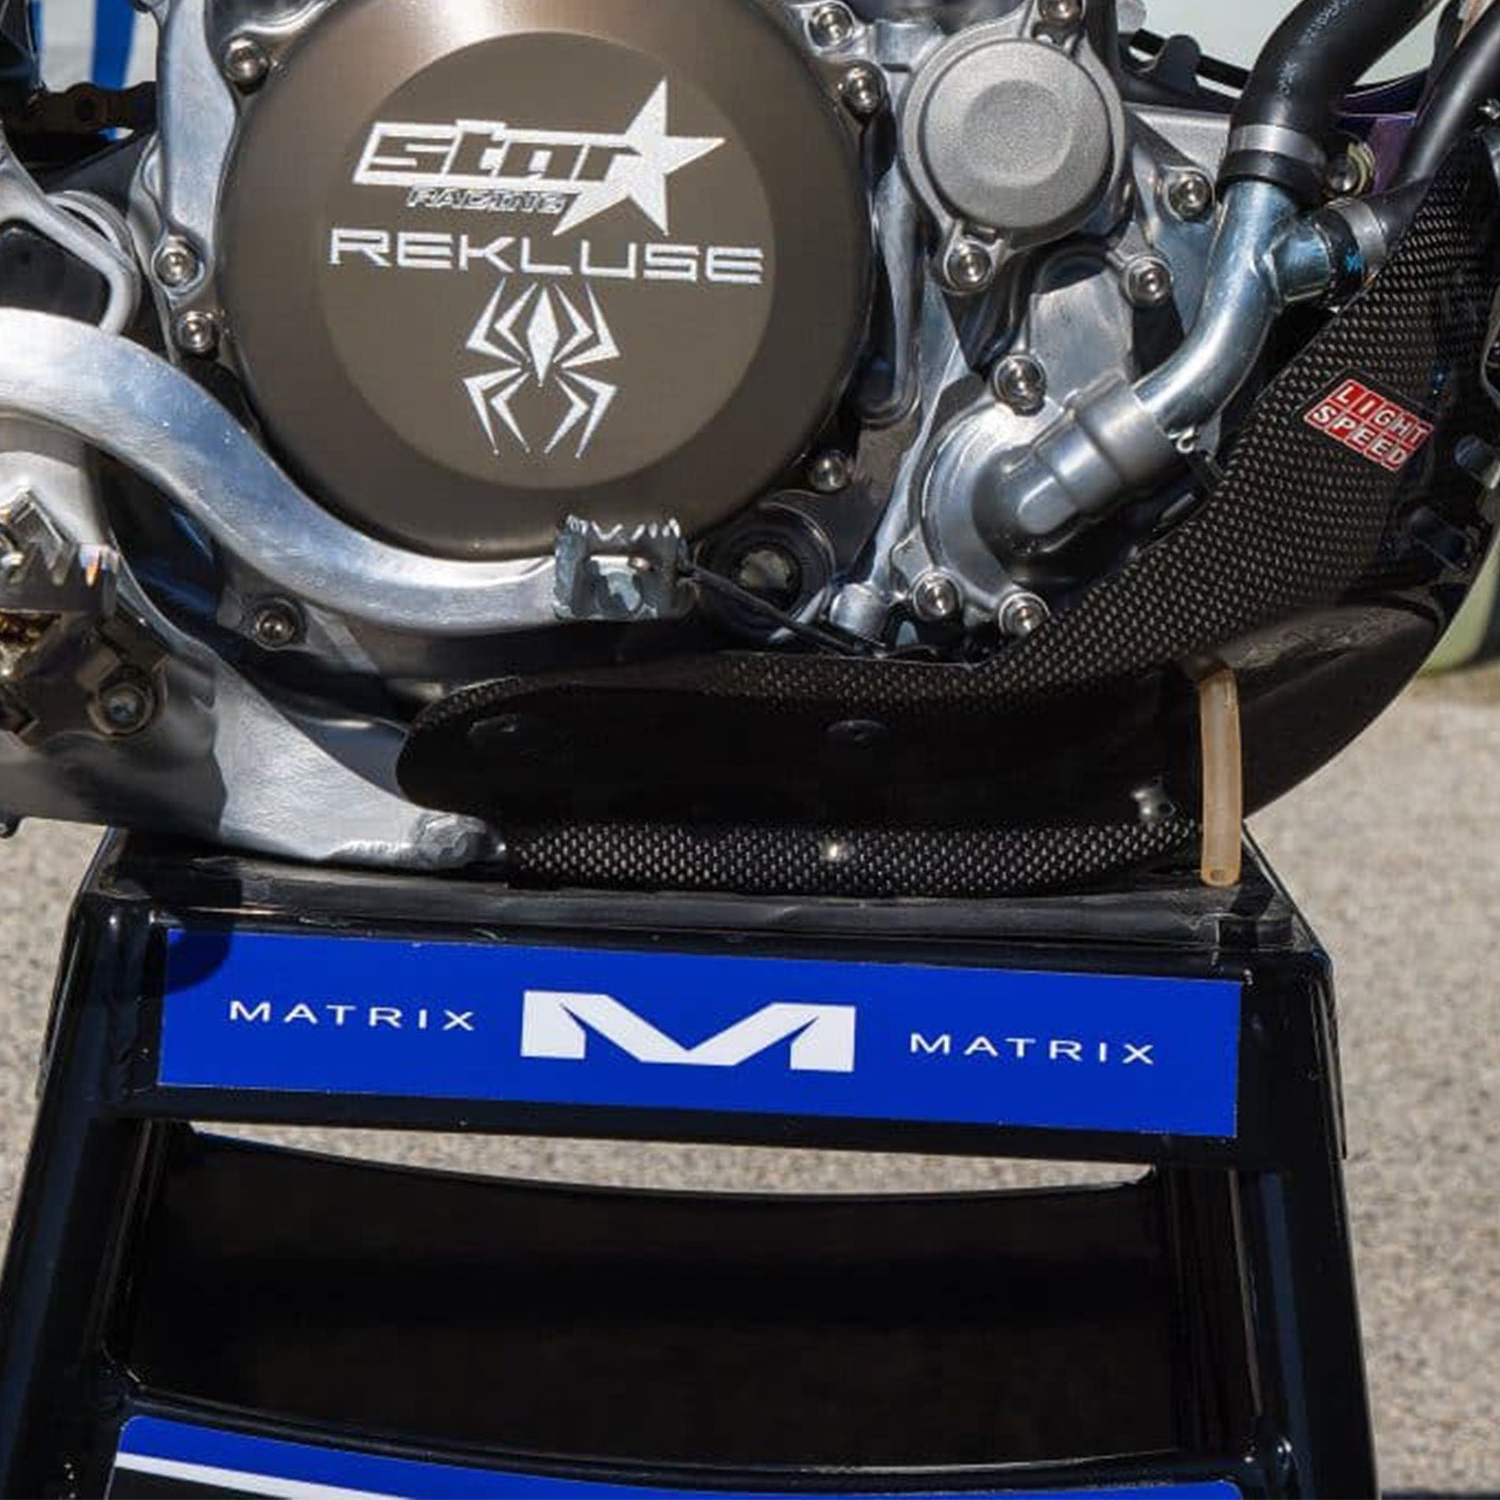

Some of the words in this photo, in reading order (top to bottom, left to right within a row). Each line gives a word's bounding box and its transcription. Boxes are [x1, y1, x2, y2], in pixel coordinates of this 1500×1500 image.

[328, 227, 764, 285] REKLUSE
[1312, 405, 1406, 463] SPEED
[1337, 386, 1428, 443] LIGHT
[228, 999, 476, 1032] MATRIX
[909, 1032, 1156, 1065] MATRIX
